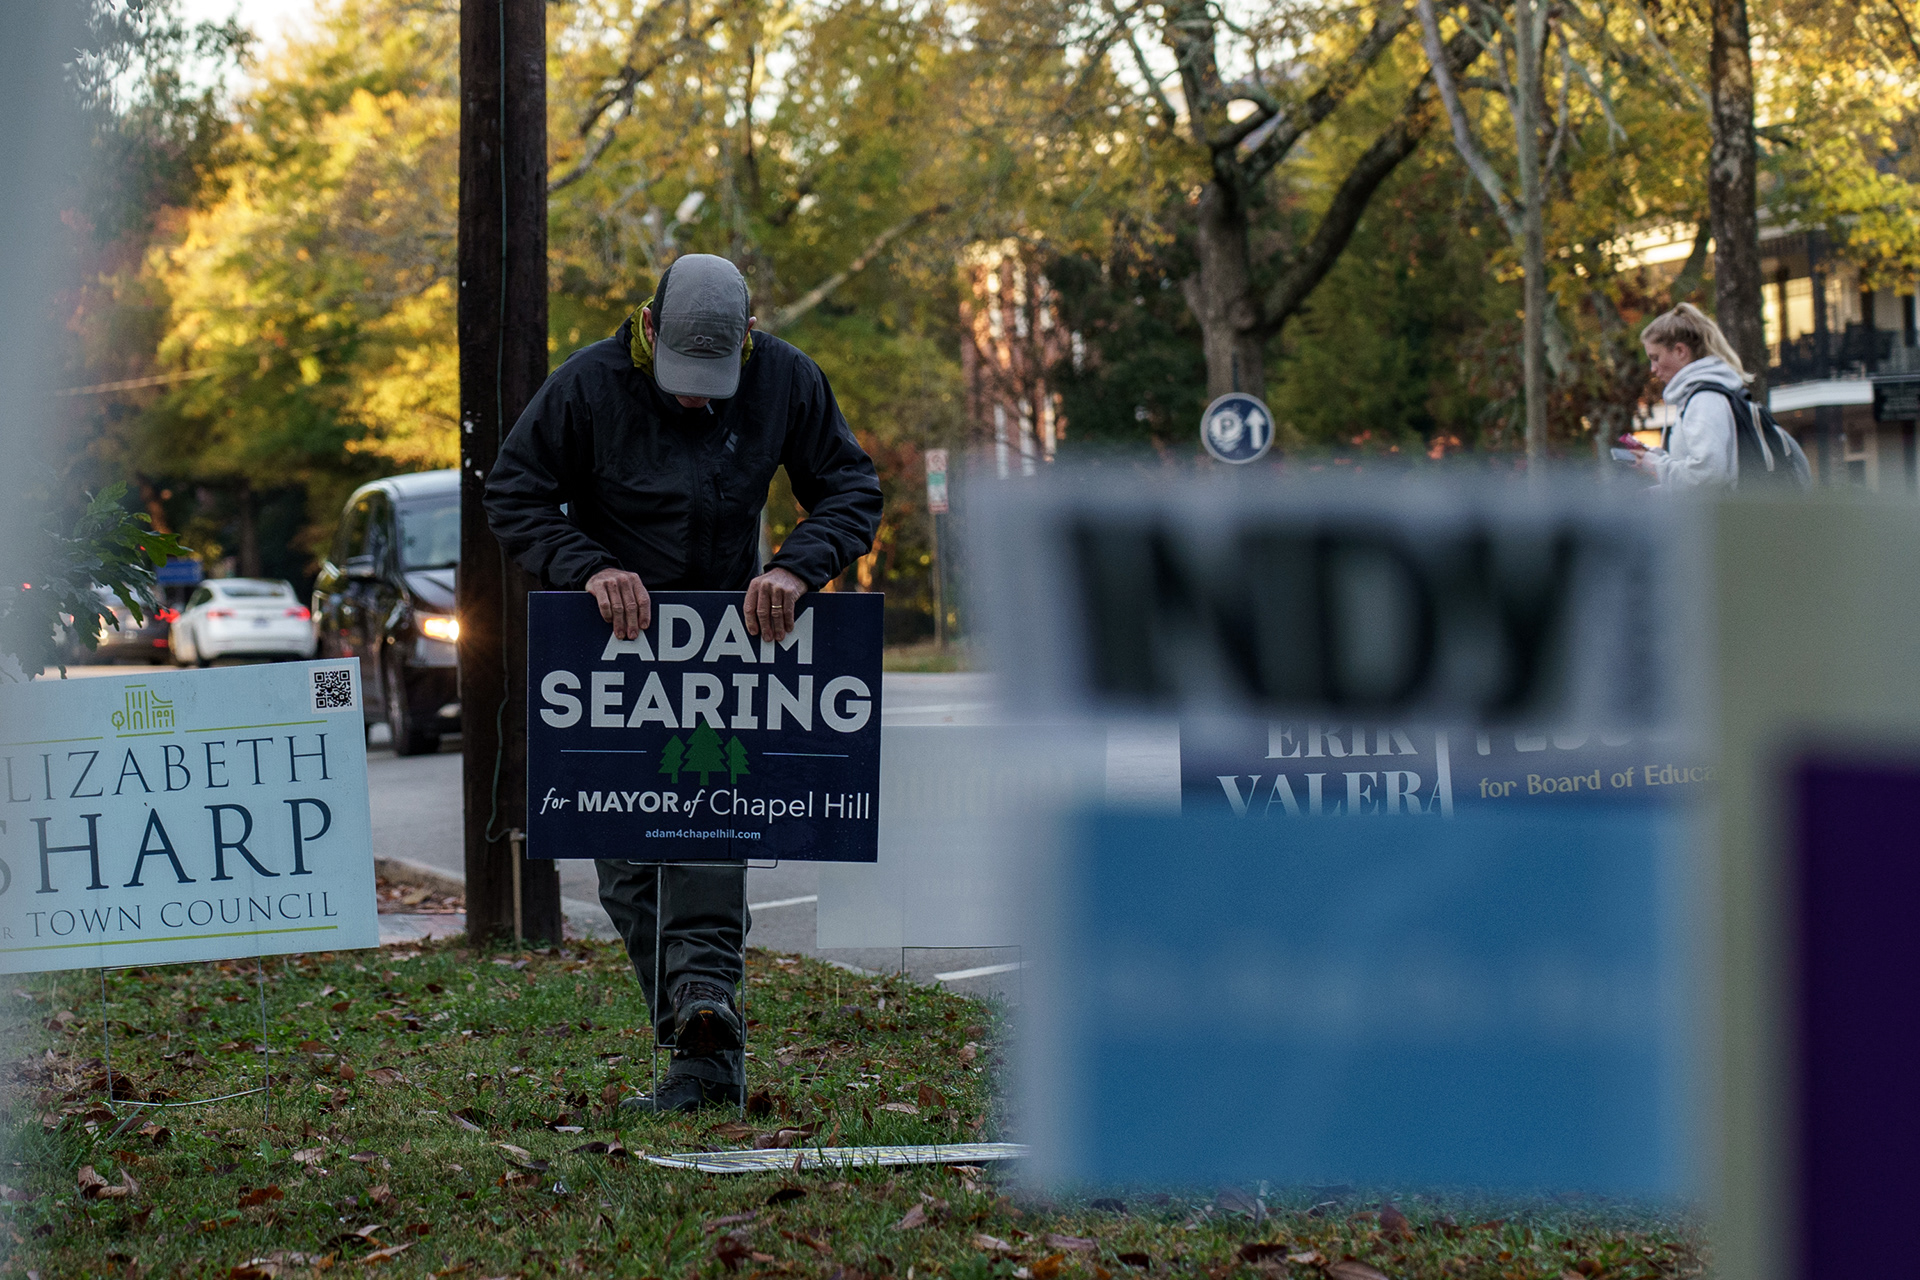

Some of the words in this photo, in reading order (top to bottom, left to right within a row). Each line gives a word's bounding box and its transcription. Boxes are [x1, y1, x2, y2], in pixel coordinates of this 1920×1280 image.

[694, 335, 713, 347] OR
[1220, 418, 1235, 436] P
[601, 604, 815, 664] ADAM
[539, 671, 873, 733] SEARING
[1265, 719, 1418, 759] ERIK
[3, 733, 332, 802] LIZABETH
[1478, 778, 1517, 798] for
[1527, 769, 1601, 795] Board
[1612, 767, 1634, 788] of
[540, 788, 571, 815] for
[578, 792, 679, 813] MAYOR
[685, 788, 706, 818] of
[710, 789, 813, 823] Chapel
[826, 793, 869, 819] Hill
[645, 829, 761, 840] adam4chapelhill.com
[26, 905, 142, 938] TOWN
[160, 891, 338, 927] COUNCIL
